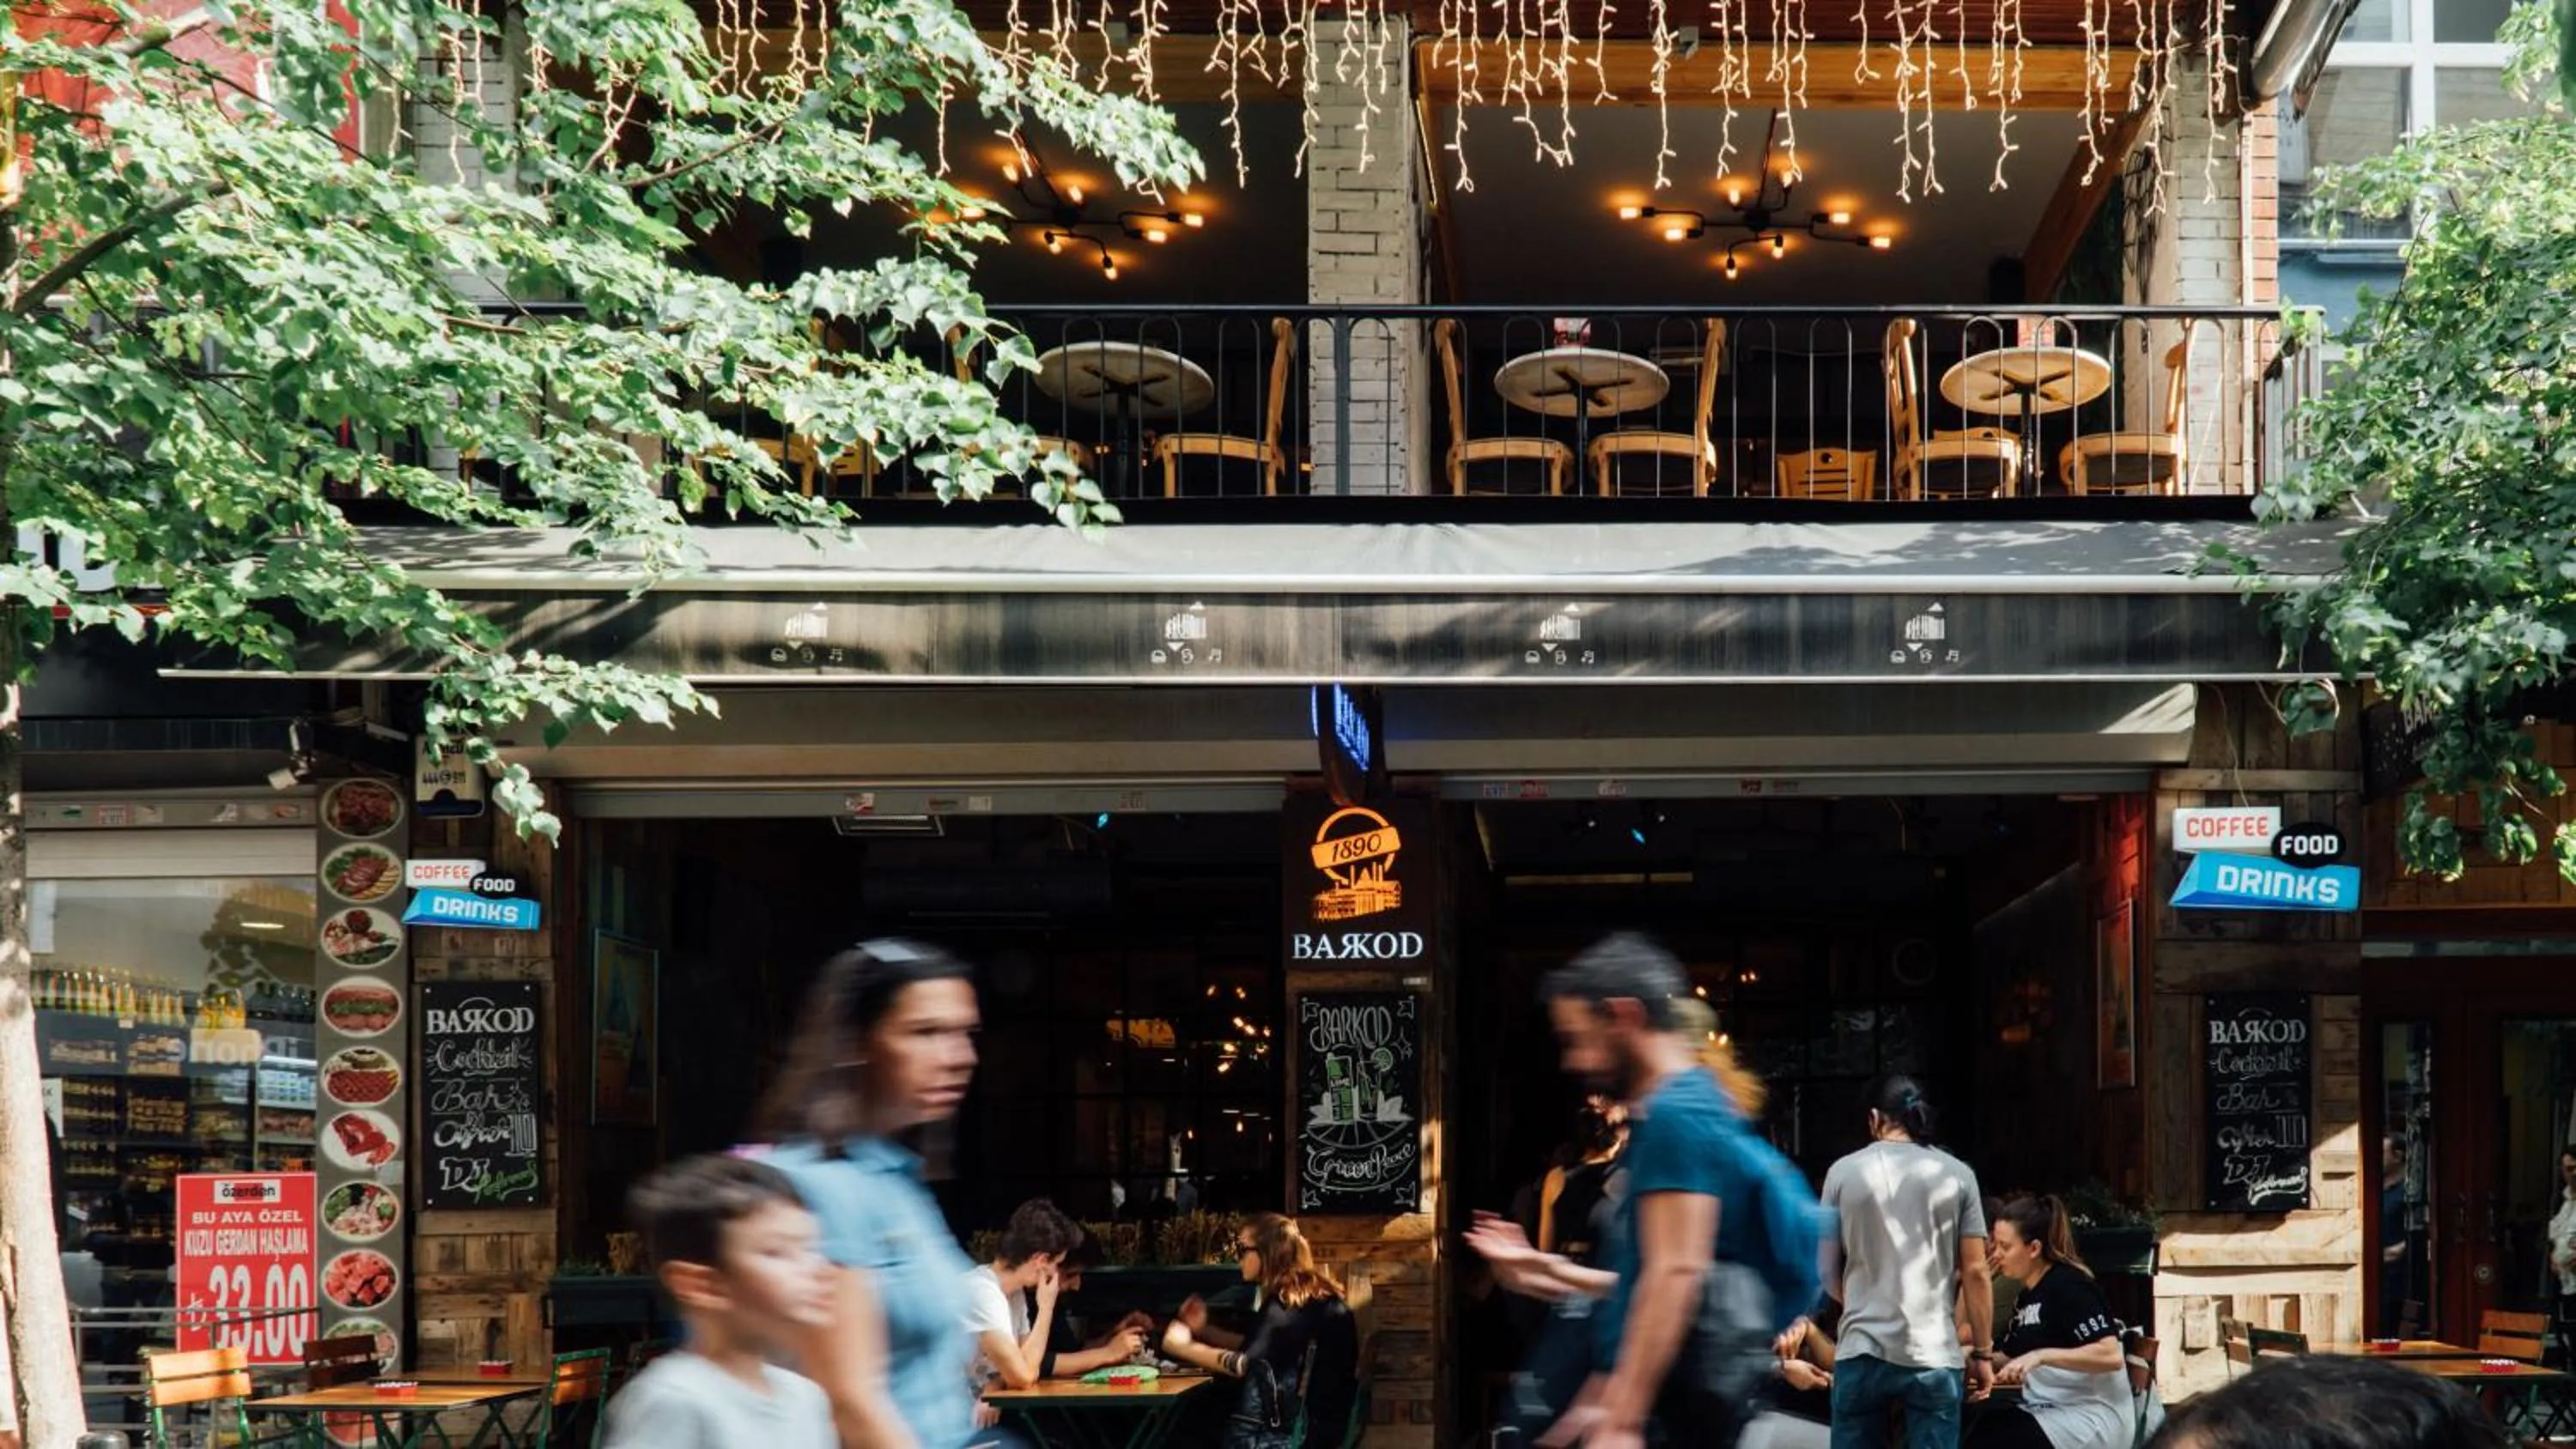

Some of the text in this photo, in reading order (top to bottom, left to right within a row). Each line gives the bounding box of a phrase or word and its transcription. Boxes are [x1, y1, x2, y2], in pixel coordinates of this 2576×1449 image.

[2185, 816, 2269, 838] COFFEE
[1332, 834, 1382, 863] 1890
[2281, 835, 2338, 855] FOOD
[413, 865, 471, 879] COFFEE
[474, 878, 515, 892] FOOD
[2217, 865, 2341, 903] DRINKS
[433, 896, 518, 922] DRINKS
[1309, 1006, 1392, 1052] BARKOD
[432, 1079, 508, 1111] Bar
[2216, 1082, 2280, 1110] Bar
[222, 1183, 276, 1198] özerden
[191, 1209, 302, 1224] BU AYA ÖZEL
[184, 1228, 309, 1262] KUZU GERDAN HAŞLAMA
